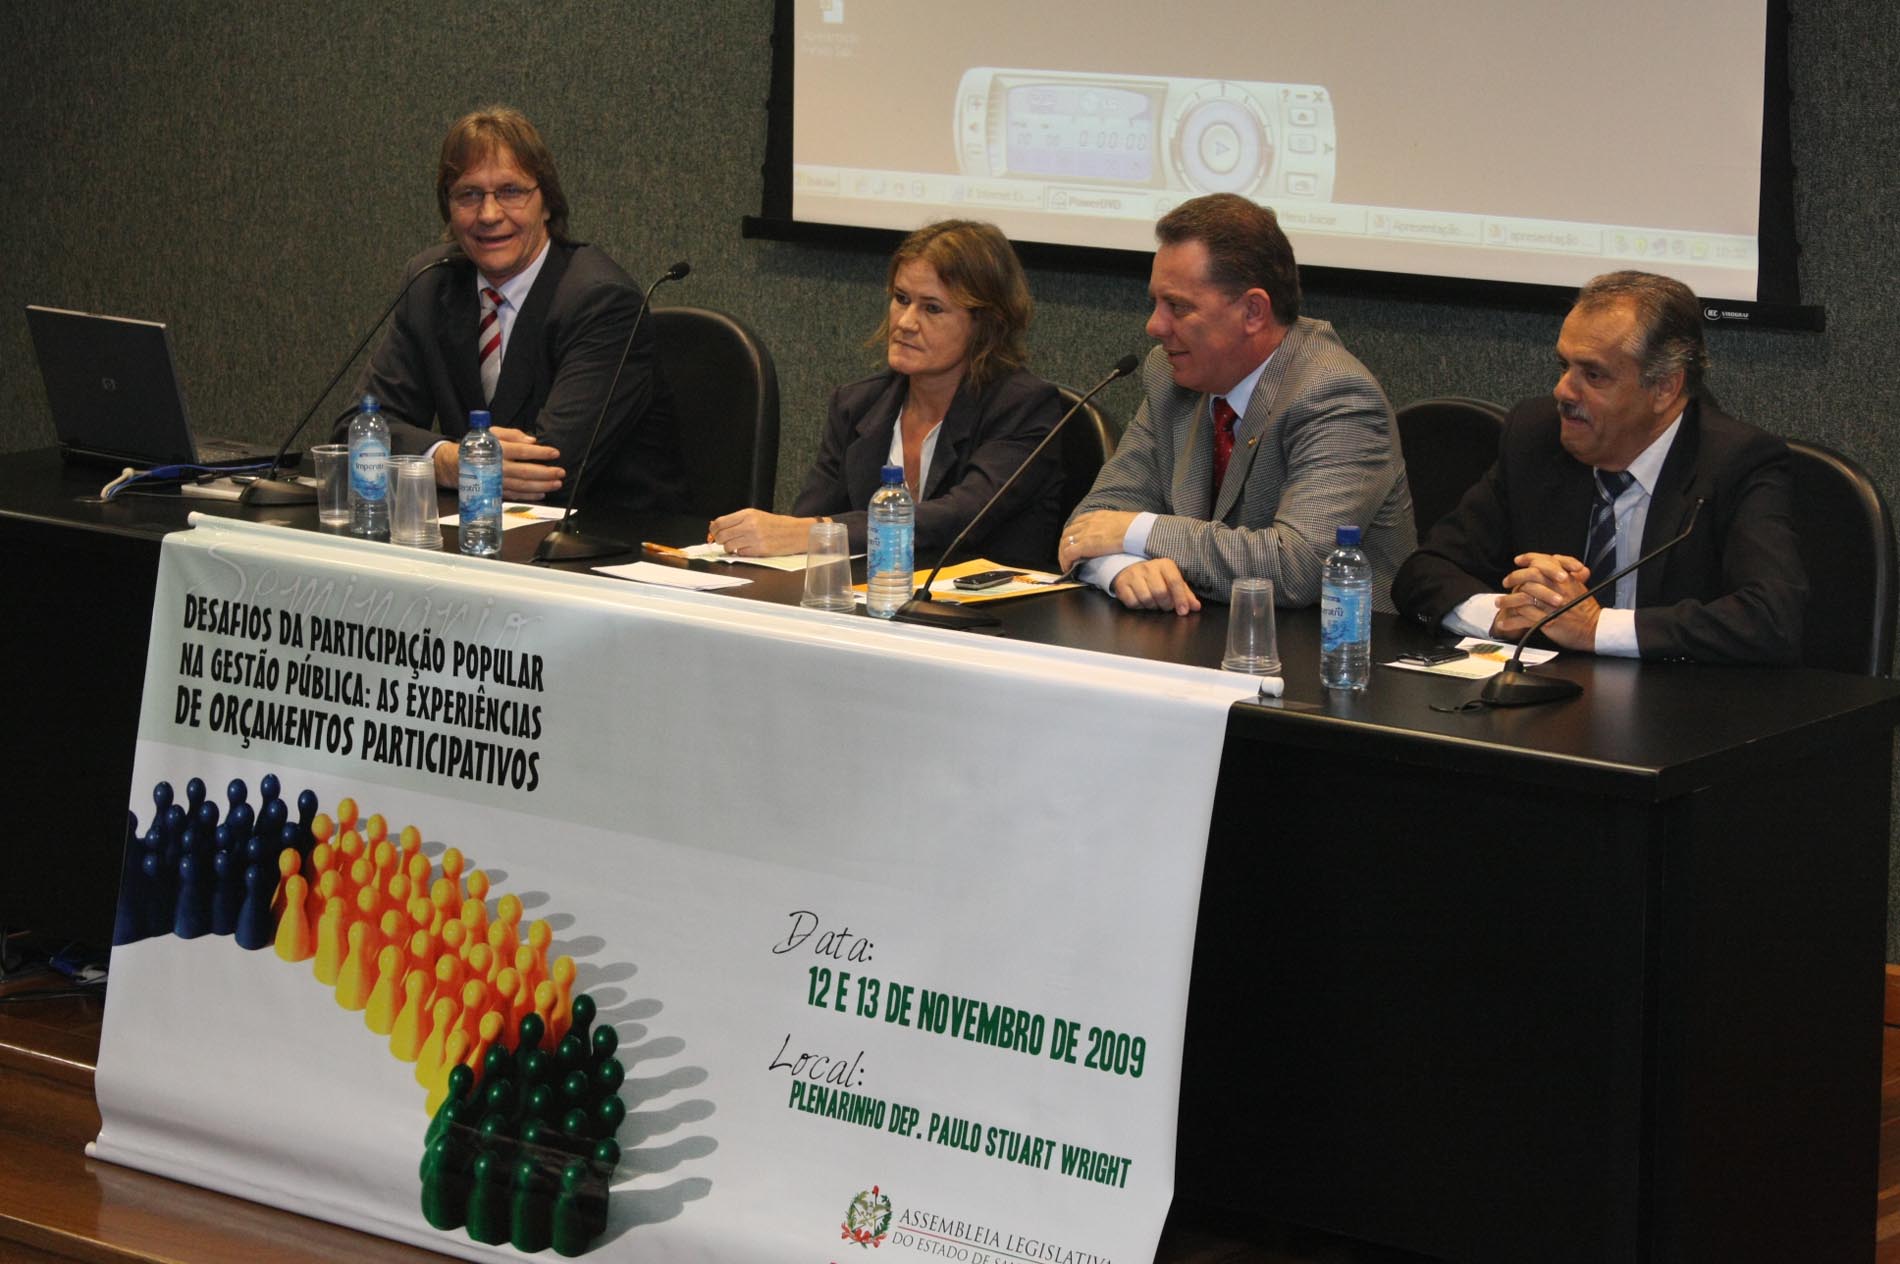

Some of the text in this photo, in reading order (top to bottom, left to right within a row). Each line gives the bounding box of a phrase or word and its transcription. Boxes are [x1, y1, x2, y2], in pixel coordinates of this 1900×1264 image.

[179, 642, 542, 741] NA GESTÃO PÚBLICA: AS EXPERIÊNCIAS
[183, 593, 545, 694] DESAFIOS DA PARTICIPAÇÃO POPULAR
[174, 685, 540, 792] DE ORÇAMENTOS PARTICIPATIVOS
[772, 910, 875, 963] Data:
[769, 1033, 865, 1088] Local:
[808, 966, 1147, 1078] 12 E 13 DE NOVEMBRO DE 2009
[788, 1080, 1132, 1189] PLENARINHO DEP. PAULO STUART WRIGHT
[892, 1231, 914, 1248] DO
[917, 1236, 969, 1262] ESTADO
[899, 1208, 1112, 1264] ASSEMBLEIA LEGISLATIV
